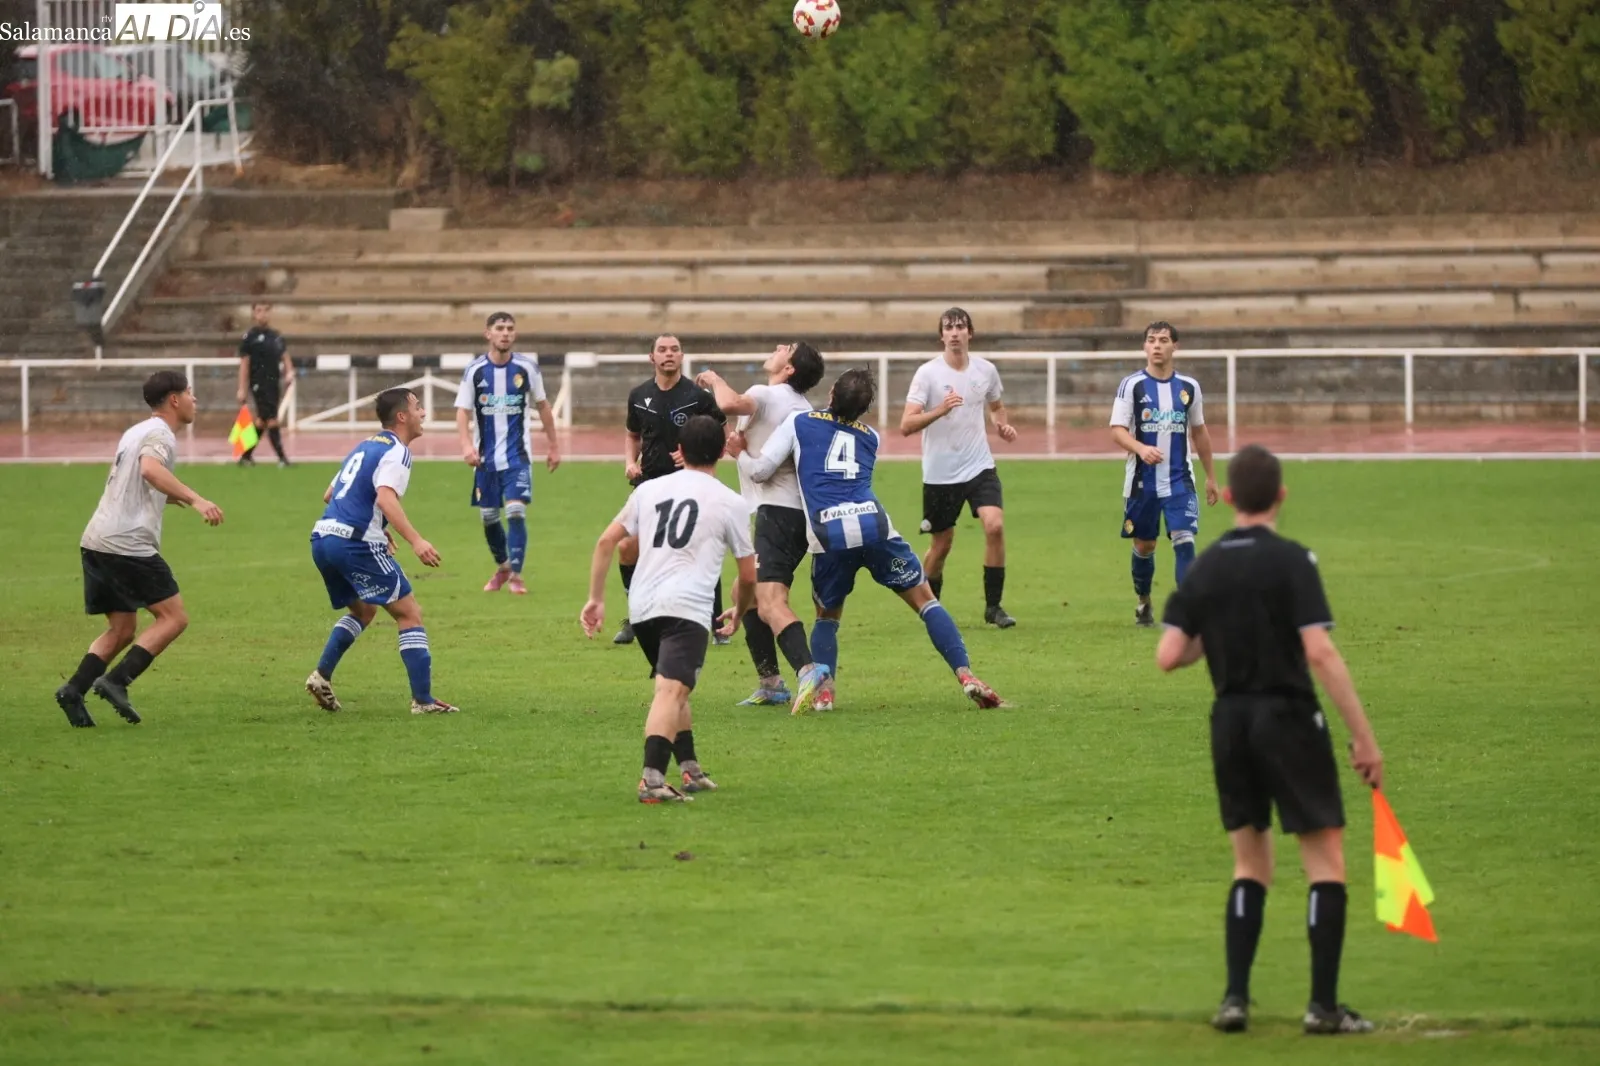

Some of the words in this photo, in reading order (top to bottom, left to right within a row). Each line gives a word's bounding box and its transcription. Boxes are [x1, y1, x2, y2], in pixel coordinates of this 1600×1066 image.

[334, 450, 365, 500] 9
[825, 430, 860, 480] 4
[652, 498, 699, 549] 10
[830, 504, 876, 518] VALCARCE
